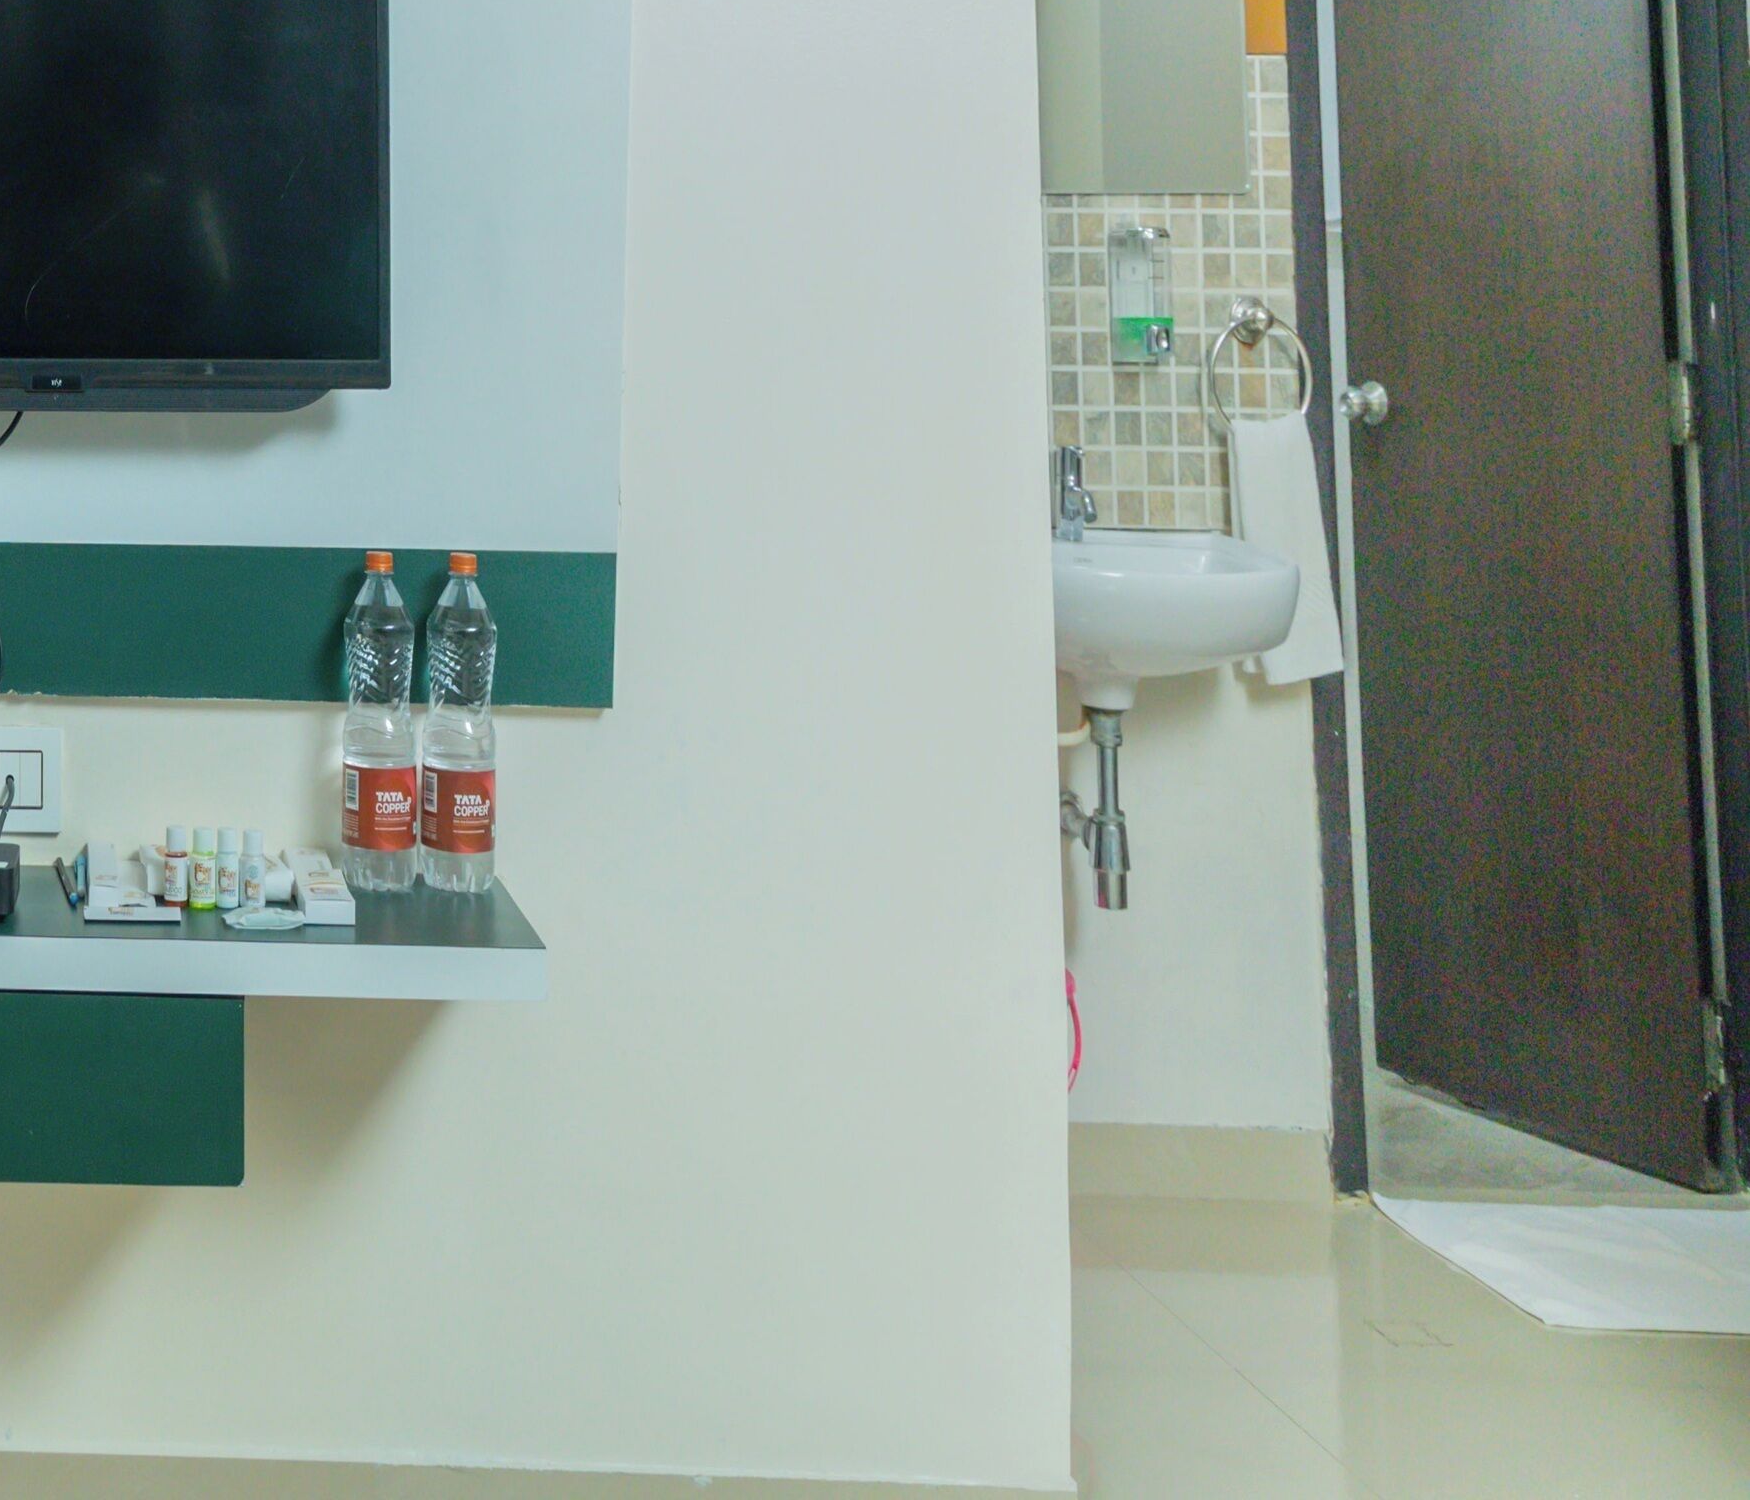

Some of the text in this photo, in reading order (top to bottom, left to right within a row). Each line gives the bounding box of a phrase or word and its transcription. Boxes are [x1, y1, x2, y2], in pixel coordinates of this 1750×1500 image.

[375, 792, 404, 803] TATA
[454, 795, 482, 805] TATA
[375, 802, 411, 814] COPPER
[453, 805, 489, 817] COPPER
